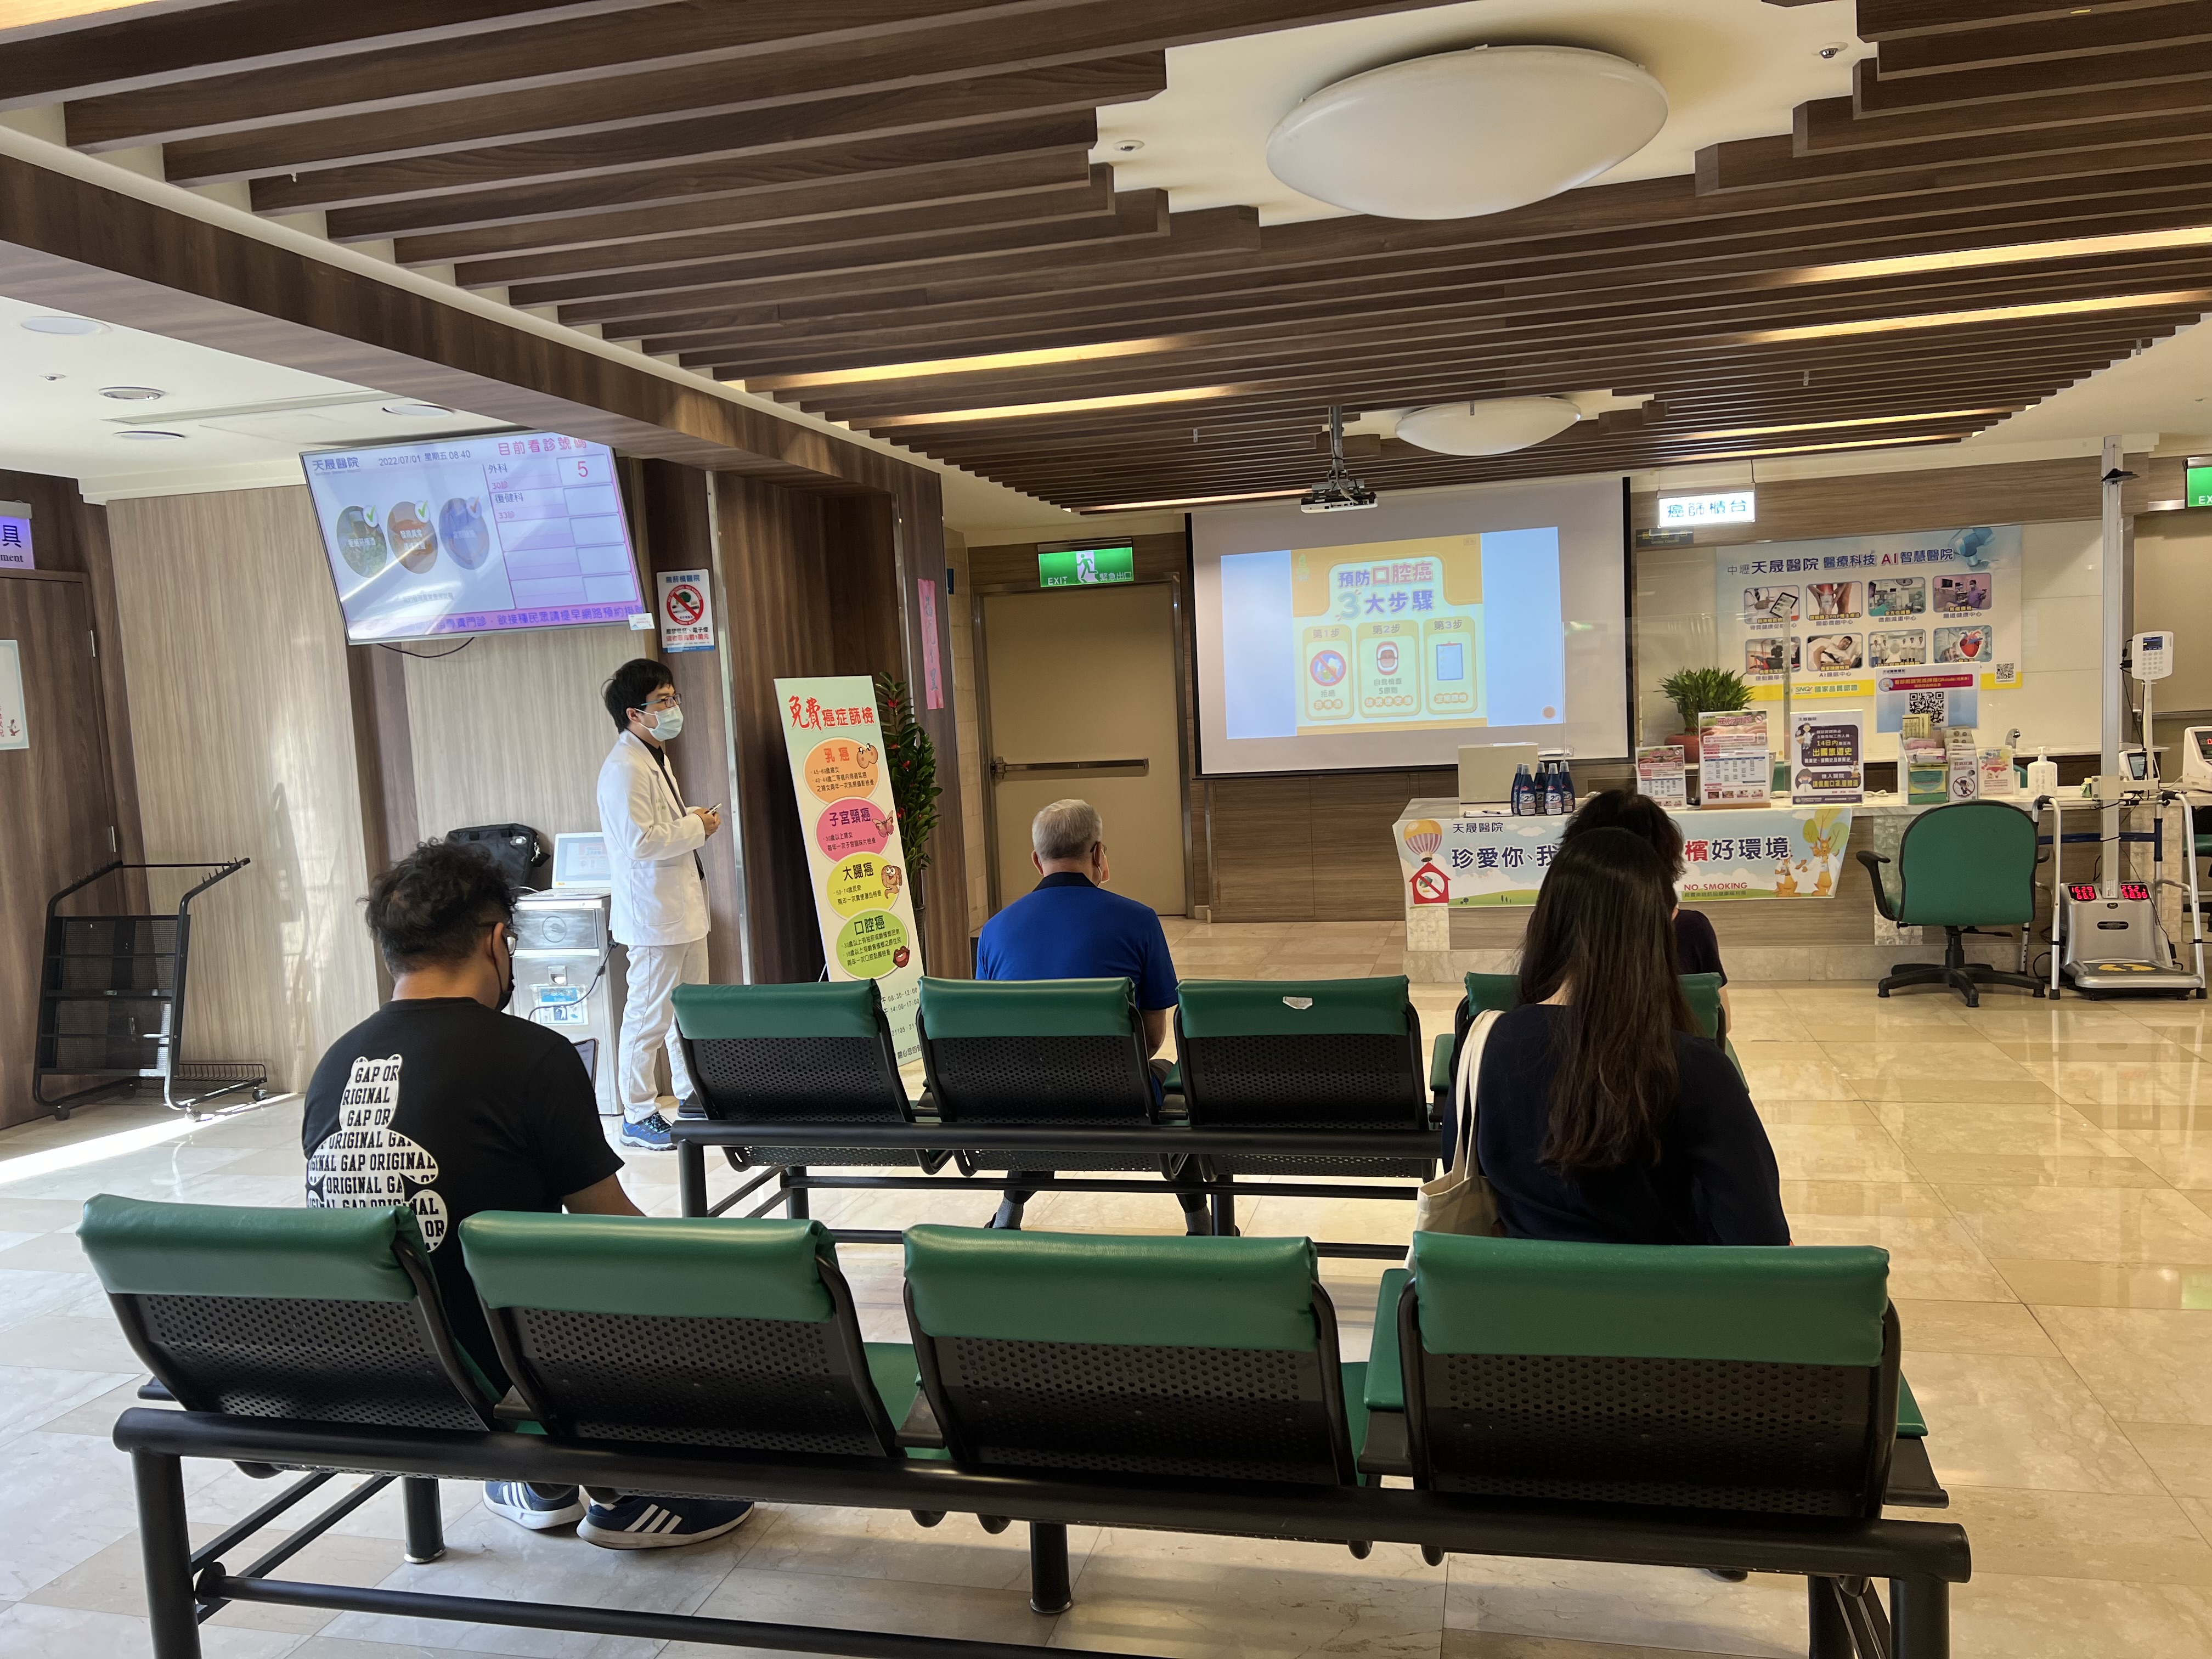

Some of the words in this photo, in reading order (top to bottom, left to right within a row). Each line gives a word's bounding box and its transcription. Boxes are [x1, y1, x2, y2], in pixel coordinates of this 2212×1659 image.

[312, 457, 359, 471] 天晟醫院
[379, 454, 421, 466] 2022/07/01
[425, 452, 448, 461] 星期五
[449, 450, 471, 459] 08:40
[488, 462, 507, 473] 外科
[577, 461, 589, 477] 5
[495, 493, 523, 503] 復健科
[1667, 500, 1747, 518] 癌篩櫃台
[2, 524, 22, 548] 具
[0, 554, 24, 563] ment
[1823, 553, 1876, 569] 醫療科技
[1047, 576, 1068, 585] EXIT
[1099, 572, 1131, 582] 緊急出口
[1338, 561, 1434, 588] 預防口腔癌
[1339, 589, 1434, 619] 3大步驟
[1373, 624, 1401, 634] 第2步
[1434, 619, 1463, 630] 第3步
[1313, 628, 1340, 639] 第1步
[1373, 678, 1402, 686] 自我檢查
[788, 695, 874, 731] 免費癌症篩檢
[823, 747, 850, 763] 乳癌
[829, 807, 871, 827] 子宮頸癌
[1452, 822, 1504, 833] 天晟醫院
[827, 837, 876, 851] 每年一次子宮頸抹片檢查
[1685, 837, 1790, 862] 檳好環境
[842, 862, 874, 882] 大腸癌
[1703, 882, 1748, 890] SMOKING
[854, 915, 885, 936] 口腔癌
[888, 987, 918, 1002] 08:30-12:00
[890, 998, 919, 1013] 14:00-17:00
[355, 1065, 380, 1083] GAP
[347, 1109, 371, 1127] GAP
[341, 1154, 365, 1171] GAP
[370, 1152, 436, 1171] ORIGINAL
[326, 1176, 382, 1194] ORIGINAL
